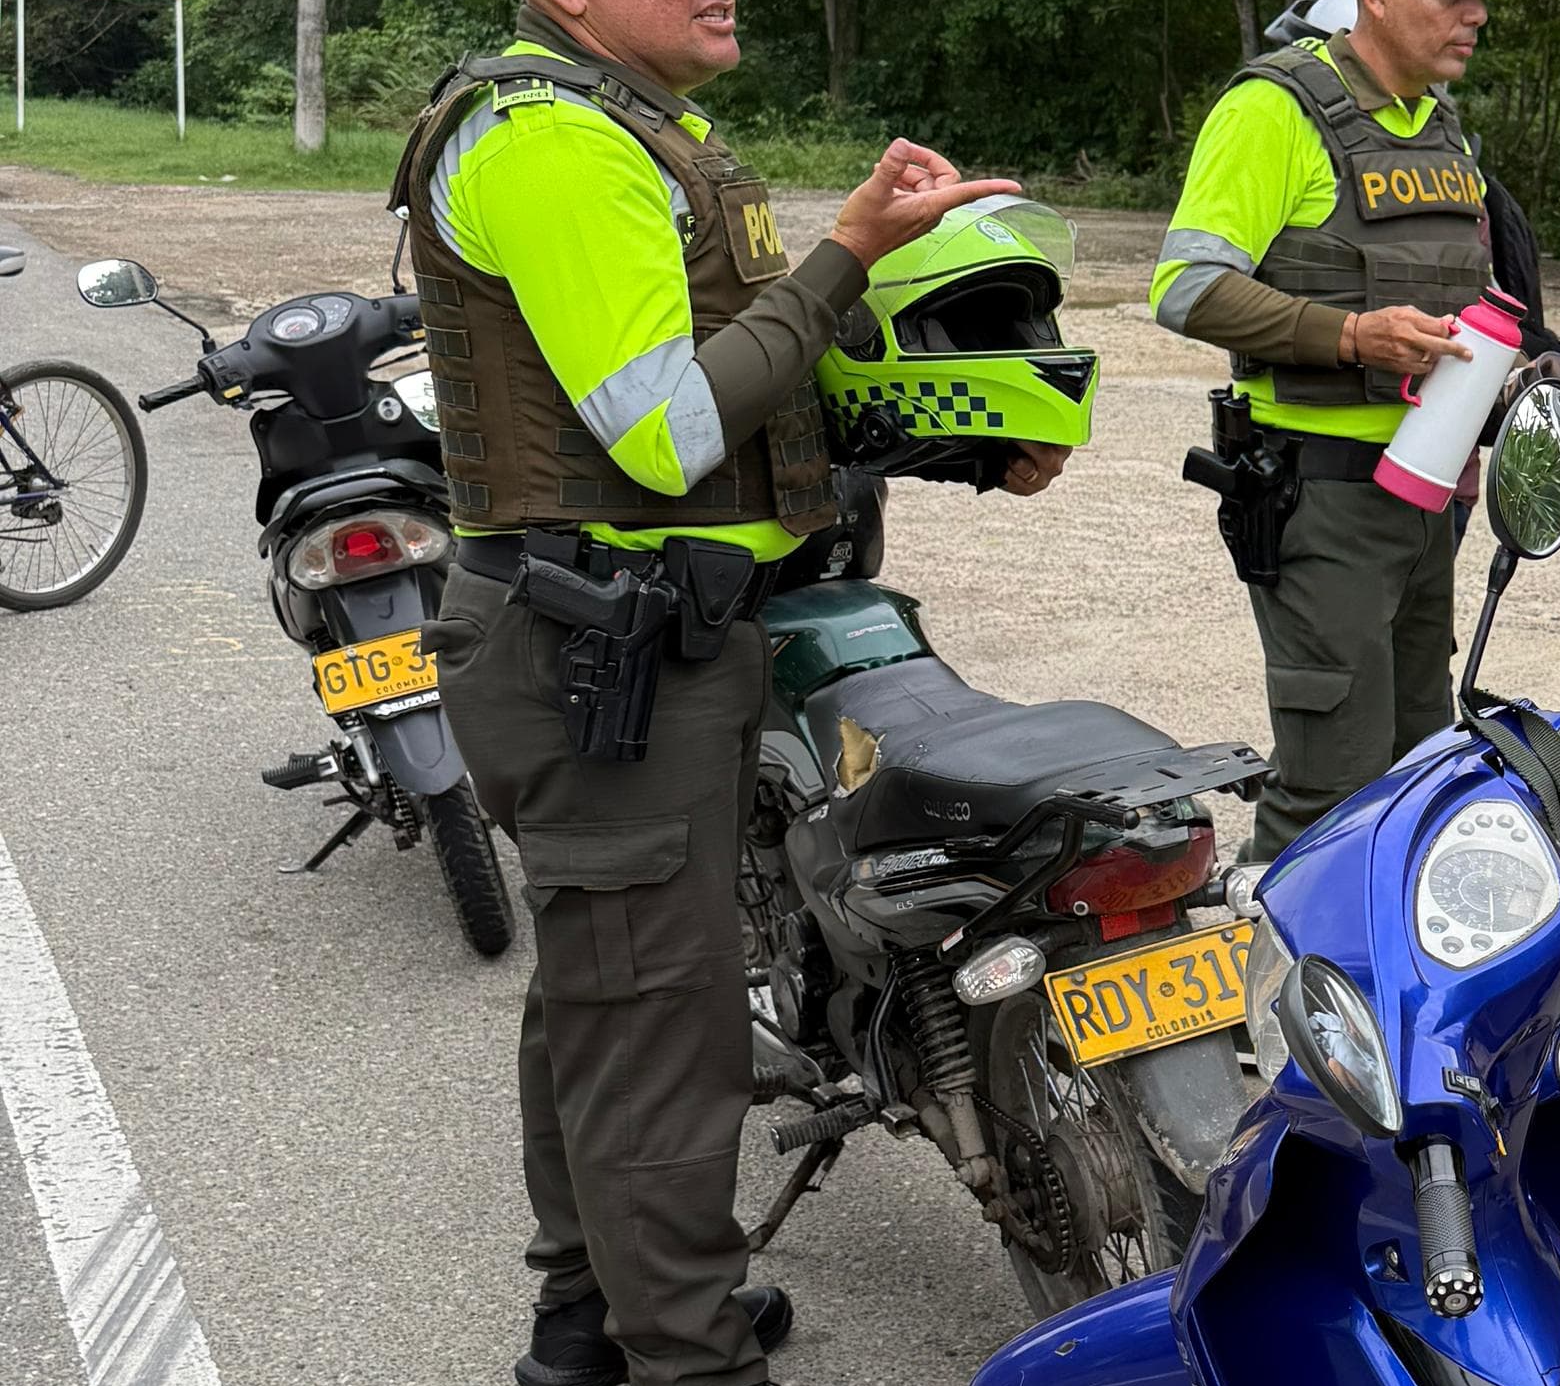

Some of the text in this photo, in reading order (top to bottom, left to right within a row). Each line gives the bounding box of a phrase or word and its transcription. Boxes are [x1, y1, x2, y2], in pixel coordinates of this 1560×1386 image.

[1362, 160, 1484, 209] POLICÍA
[323, 639, 437, 695] GTG 3
[375, 674, 434, 696] COLOMBIA
[1062, 968, 1157, 1043] RDY
[1146, 1009, 1216, 1039] COLOMBIA
